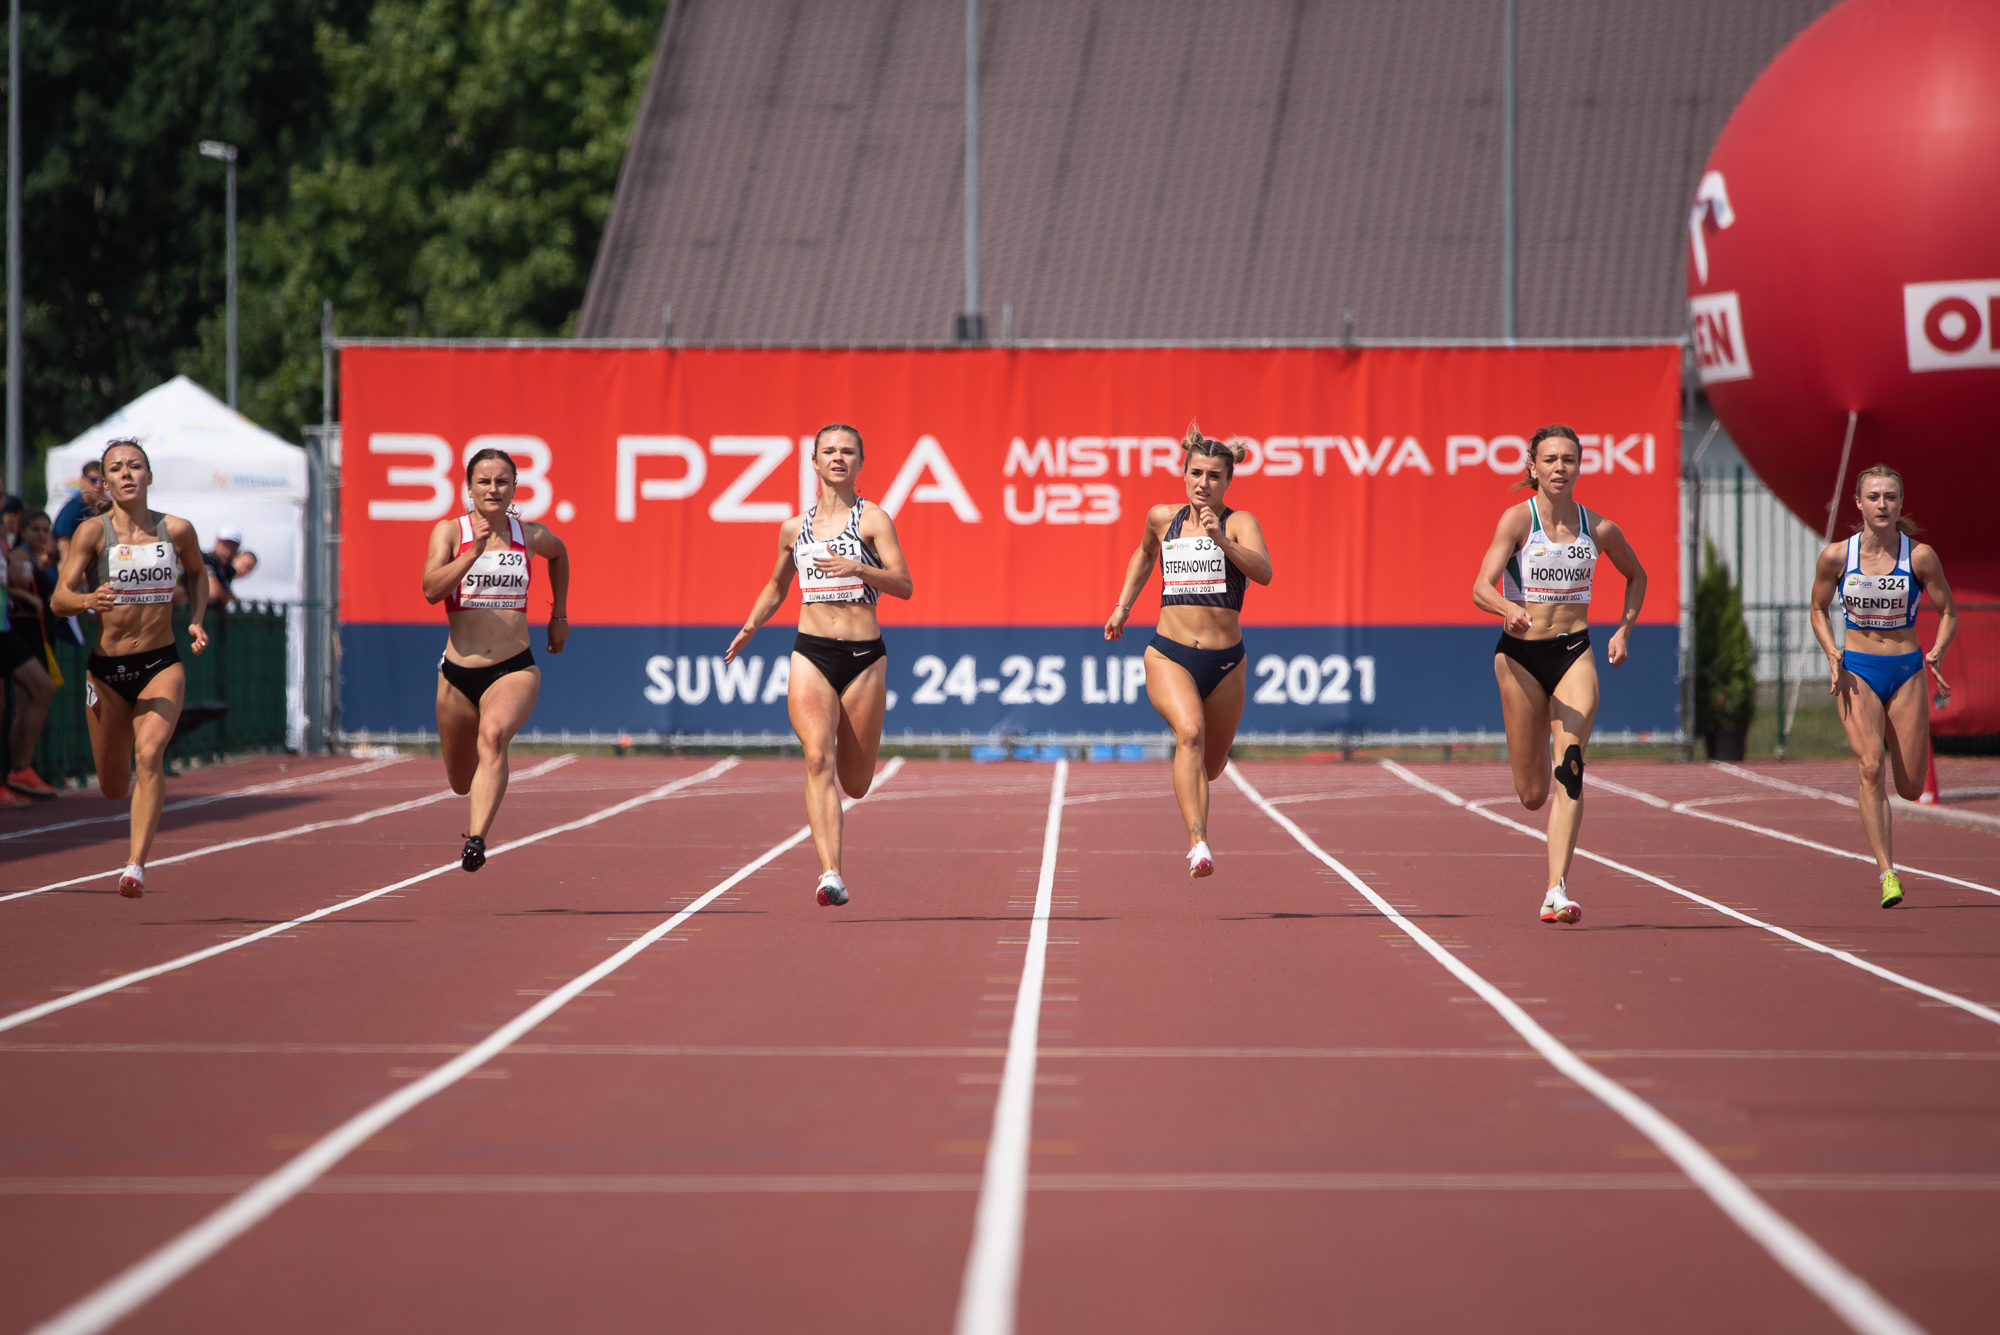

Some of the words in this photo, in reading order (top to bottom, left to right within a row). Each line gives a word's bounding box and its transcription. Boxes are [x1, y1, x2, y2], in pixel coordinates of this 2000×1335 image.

[1923, 295, 2000, 357] O
[1003, 435, 1434, 477] MISTROSTWA
[1445, 433, 1655, 477] POSKI
[368, 432, 576, 523] 38.
[1003, 483, 1120, 525] U23
[156, 544, 165, 558] 5
[830, 543, 857, 556] 351
[1567, 545, 1592, 559] 385
[498, 553, 523, 566] 239
[1165, 559, 1222, 574] STEFANOWICZ
[118, 567, 172, 585] GĄSIOR
[466, 574, 523, 588] STRUZIK
[1531, 567, 1591, 581] HOROWSKA
[1878, 578, 1906, 591] 324
[837, 591, 853, 599] 2021
[1845, 595, 1905, 609] BRENDEL
[643, 655, 899, 711] SUWA,
[911, 654, 1067, 705] 24-25
[1081, 655, 1147, 704] LIP
[1253, 654, 1376, 706] 2021
